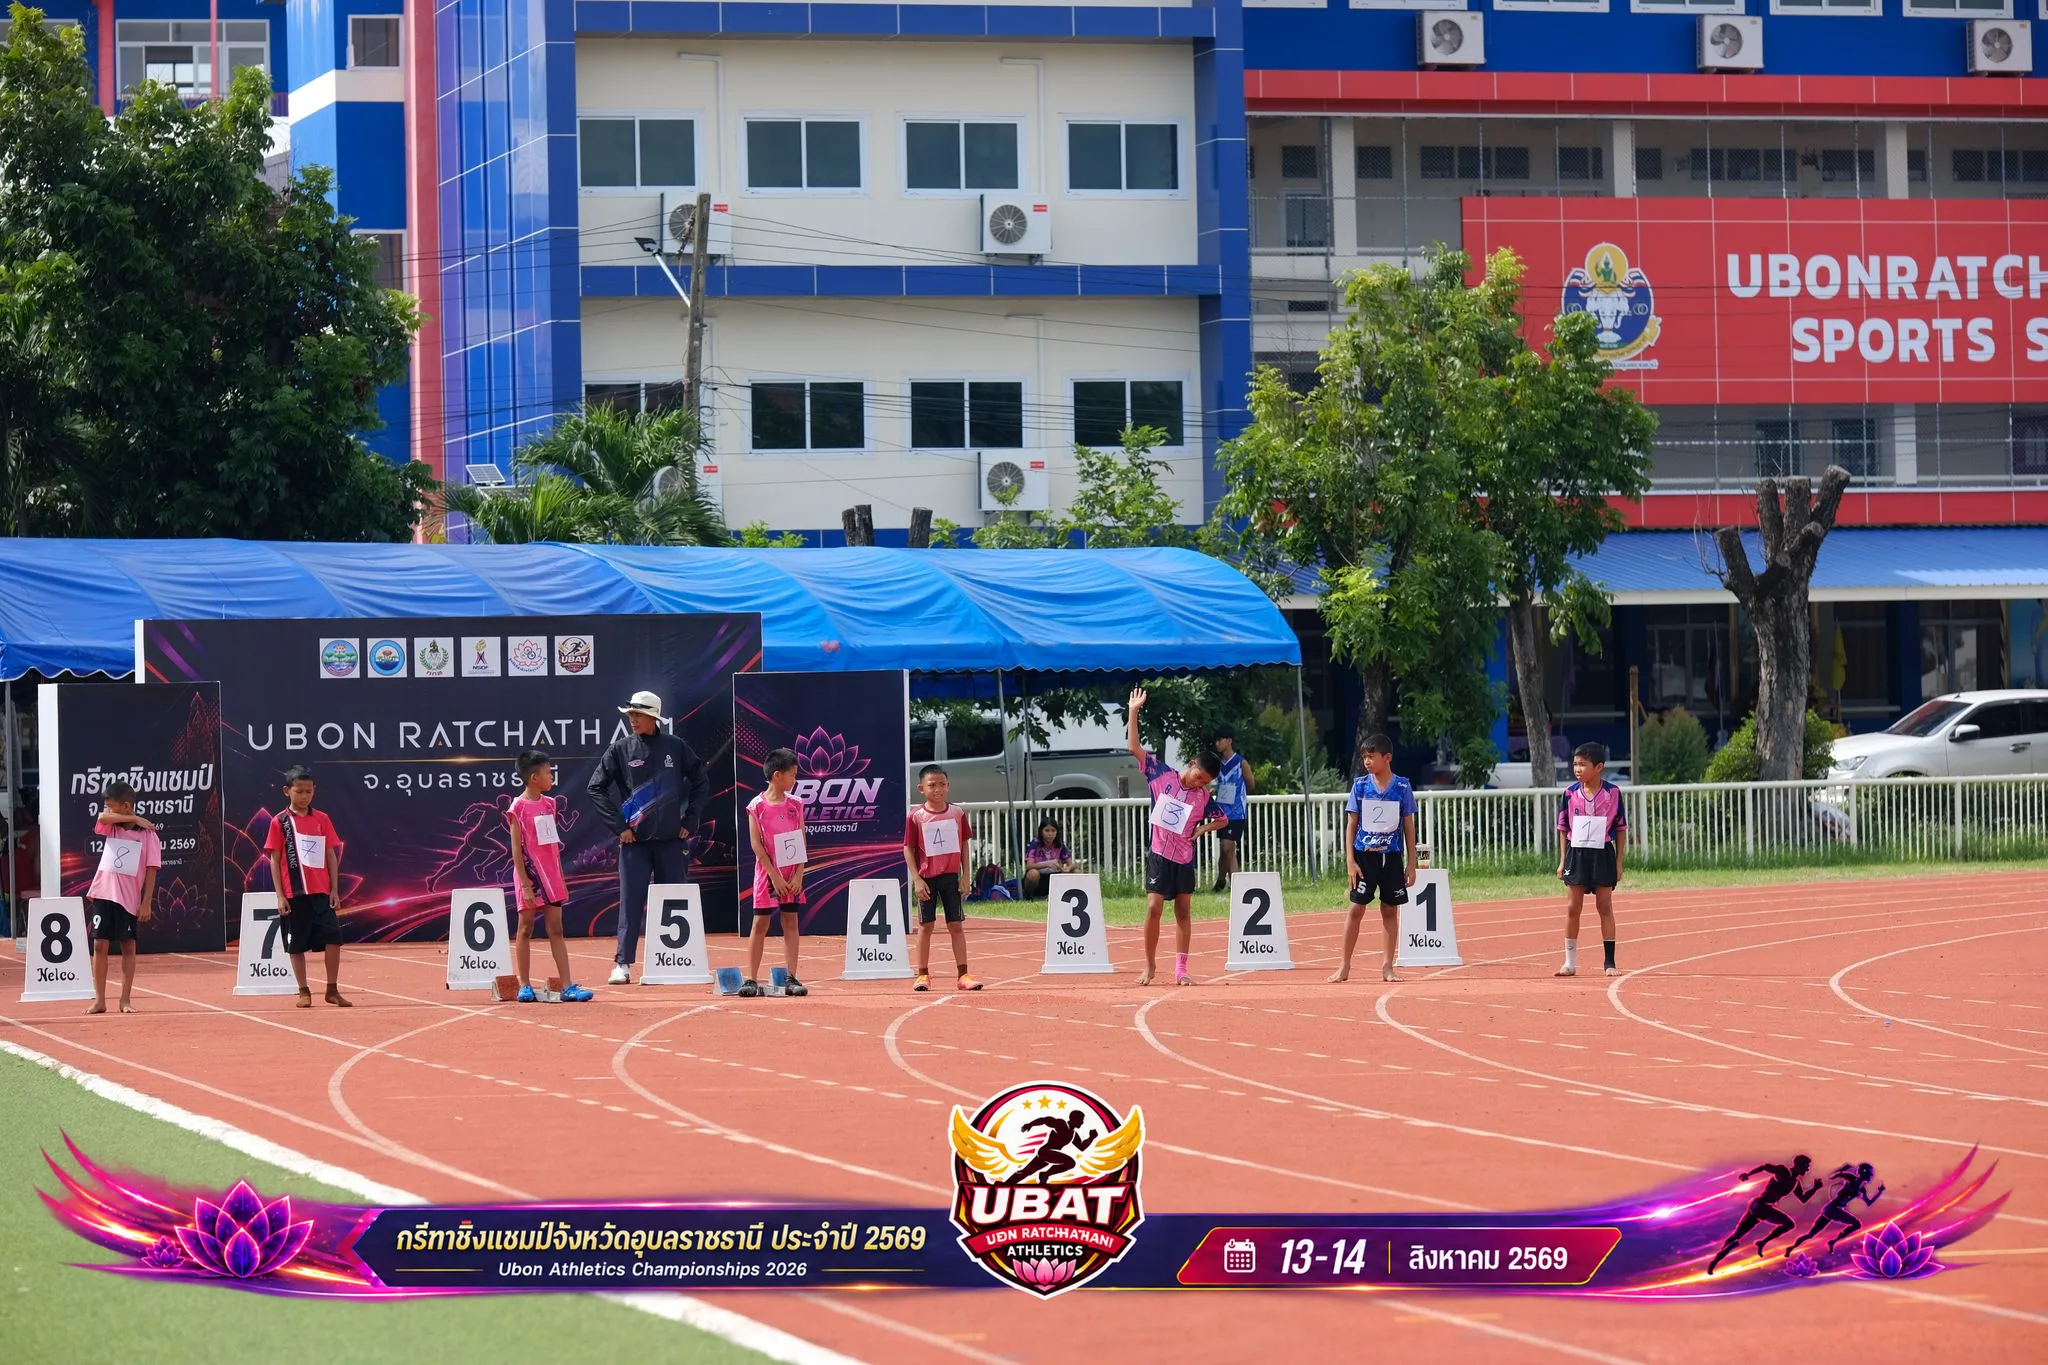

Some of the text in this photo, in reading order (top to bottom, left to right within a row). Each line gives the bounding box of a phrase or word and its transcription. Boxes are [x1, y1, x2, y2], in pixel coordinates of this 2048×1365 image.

[1791, 316, 1996, 364] SPORTS
[561, 655, 588, 663] UBAT
[247, 716, 674, 751] UBON RATCHATHAI
[796, 777, 885, 805] BON
[803, 805, 880, 820] LETICS
[1162, 801, 1185, 826] 3
[1372, 806, 1388, 824] 2
[932, 827, 946, 848] 4
[1578, 820, 1597, 843] 1
[169, 838, 196, 850] 2569
[301, 839, 317, 858] 7
[784, 838, 797, 860] 5
[113, 846, 130, 869] 8
[1356, 881, 1367, 894] 5
[1060, 888, 1091, 938] 3
[1241, 887, 1273, 936] 2
[1415, 882, 1437, 932] 1
[93, 914, 102, 930] 9
[463, 901, 496, 952] 6
[659, 898, 691, 949] 5
[860, 894, 892, 945] 4
[40, 912, 73, 964] 8
[252, 908, 281, 960] 7
[1408, 933, 1442, 948] Nelco
[857, 948, 894, 962] Nelco
[1056, 941, 1085, 955] Nelc
[1239, 940, 1274, 954] Nelco
[249, 962, 288, 977] Nelco
[459, 955, 497, 970] Nelco
[655, 952, 692, 967] Nelco
[37, 967, 76, 982] Nelco
